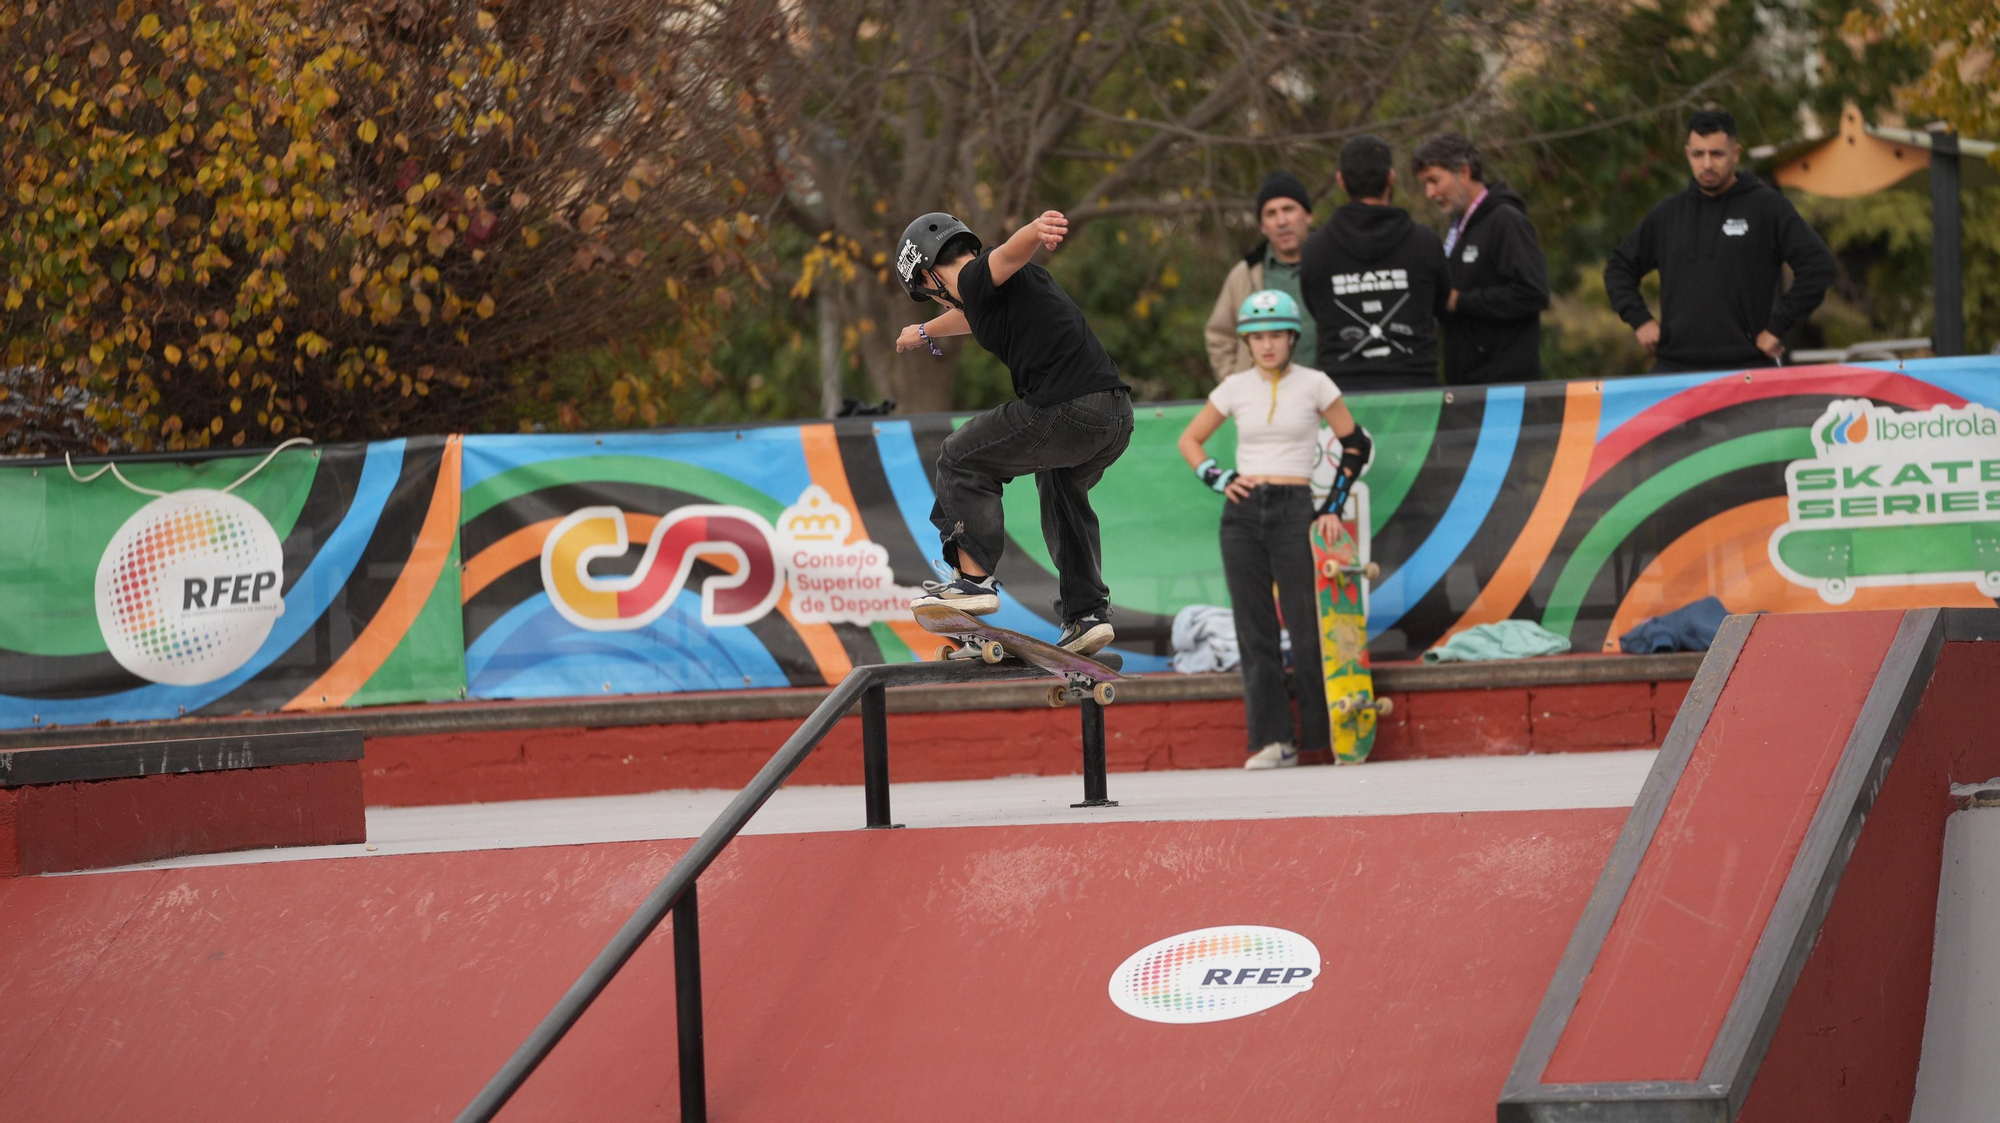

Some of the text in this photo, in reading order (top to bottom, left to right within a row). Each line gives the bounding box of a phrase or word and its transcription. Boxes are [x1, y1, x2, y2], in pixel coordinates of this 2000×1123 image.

[1331, 268, 1408, 284] SKATE
[1876, 412, 1997, 441] Iberdrola
[793, 549, 878, 571] Consejo
[183, 571, 277, 611] RFEP
[797, 571, 883, 593] Superior
[800, 594, 911, 617] de Deporte
[1201, 967, 1312, 985] RFEP
